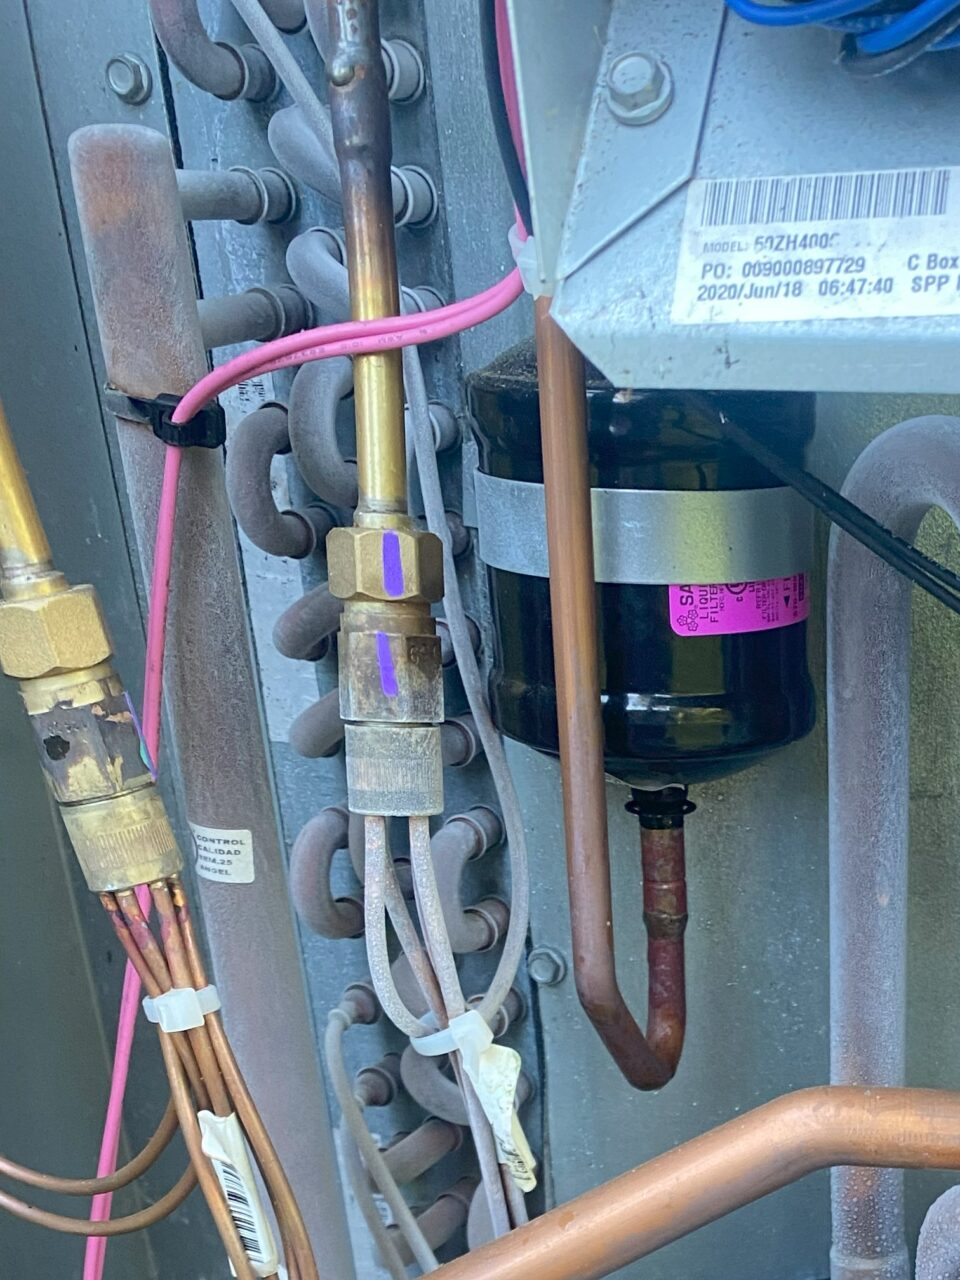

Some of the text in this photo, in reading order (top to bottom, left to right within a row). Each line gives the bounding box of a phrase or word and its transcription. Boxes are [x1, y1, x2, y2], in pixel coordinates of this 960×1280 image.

[926, 253, 960, 271] Box
[701, 263, 732, 280] PO:
[696, 281, 803, 302] 2020/Jun/18
[818, 277, 894, 297] 06:47:40
[911, 274, 950, 292] SPP
[197, 834, 245, 846] CONTROL
[197, 844, 241, 856] CALIDAD
